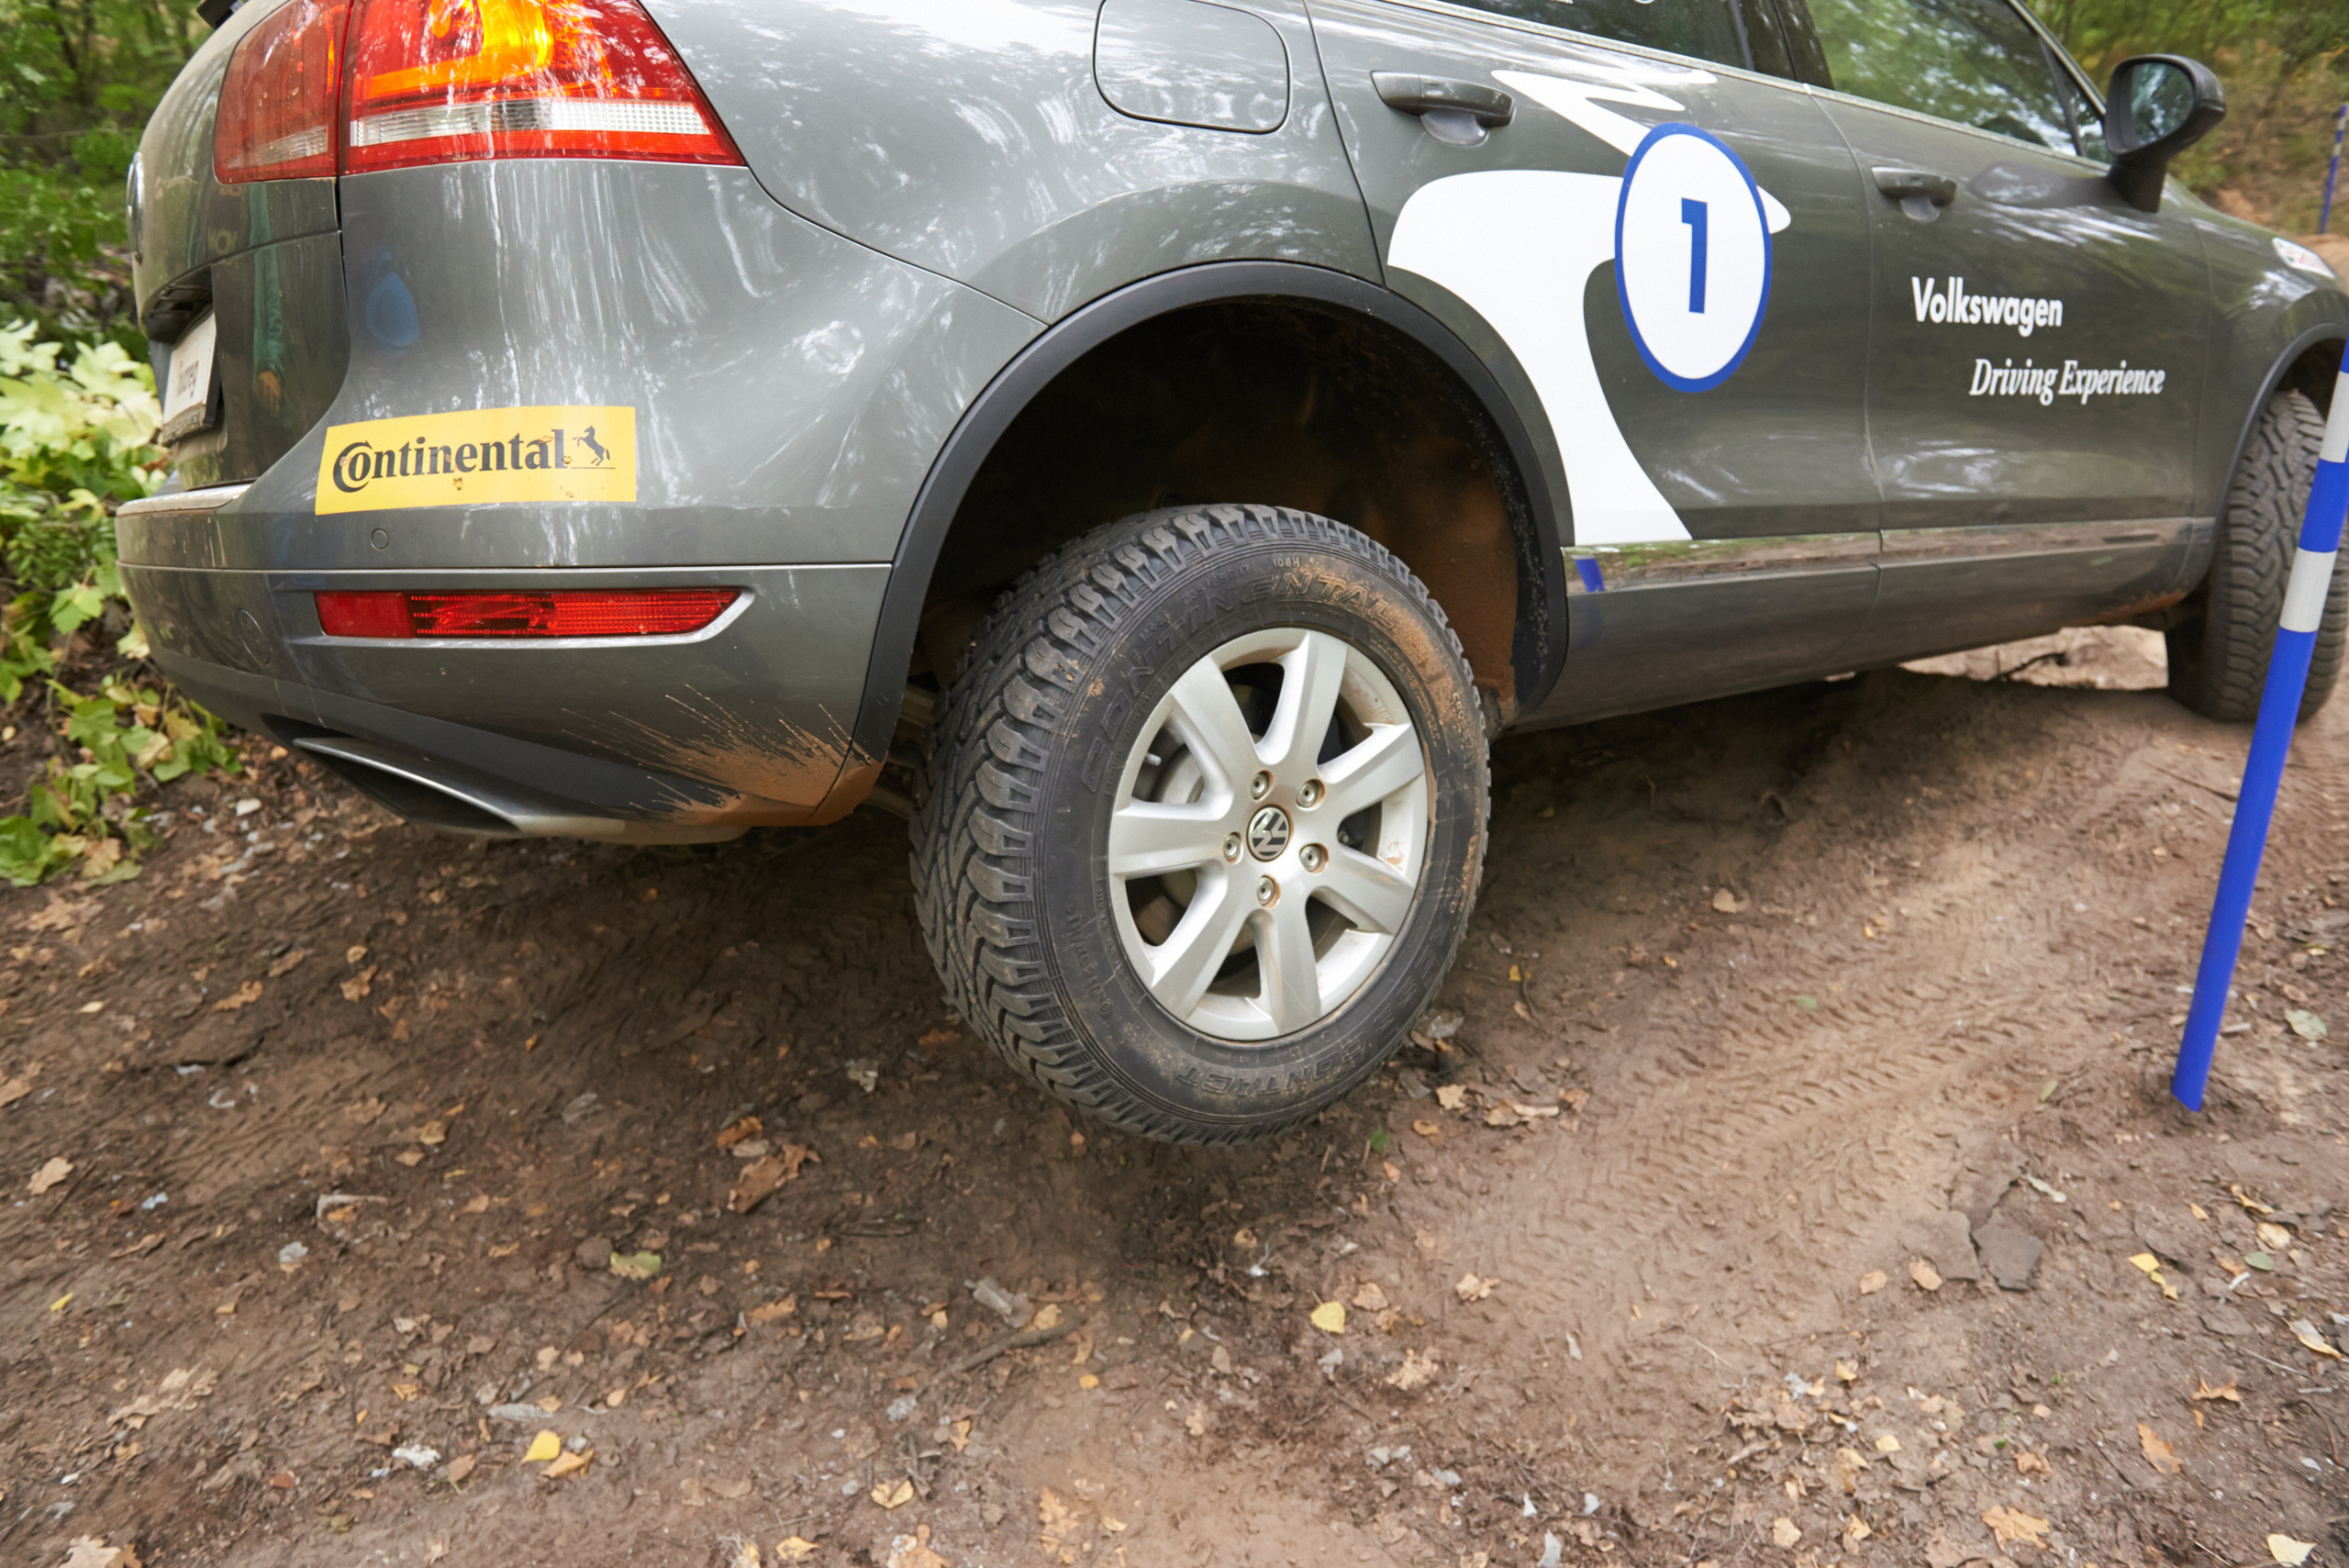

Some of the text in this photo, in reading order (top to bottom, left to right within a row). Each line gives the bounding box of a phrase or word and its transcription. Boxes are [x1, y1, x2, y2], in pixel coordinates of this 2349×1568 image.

[1681, 197, 1708, 314] 1
[1911, 276, 2063, 337] Volkswagen
[1969, 359, 2165, 406] Driving Experience
[332, 428, 568, 493] Continental
[1273, 556, 1301, 568] 108H
